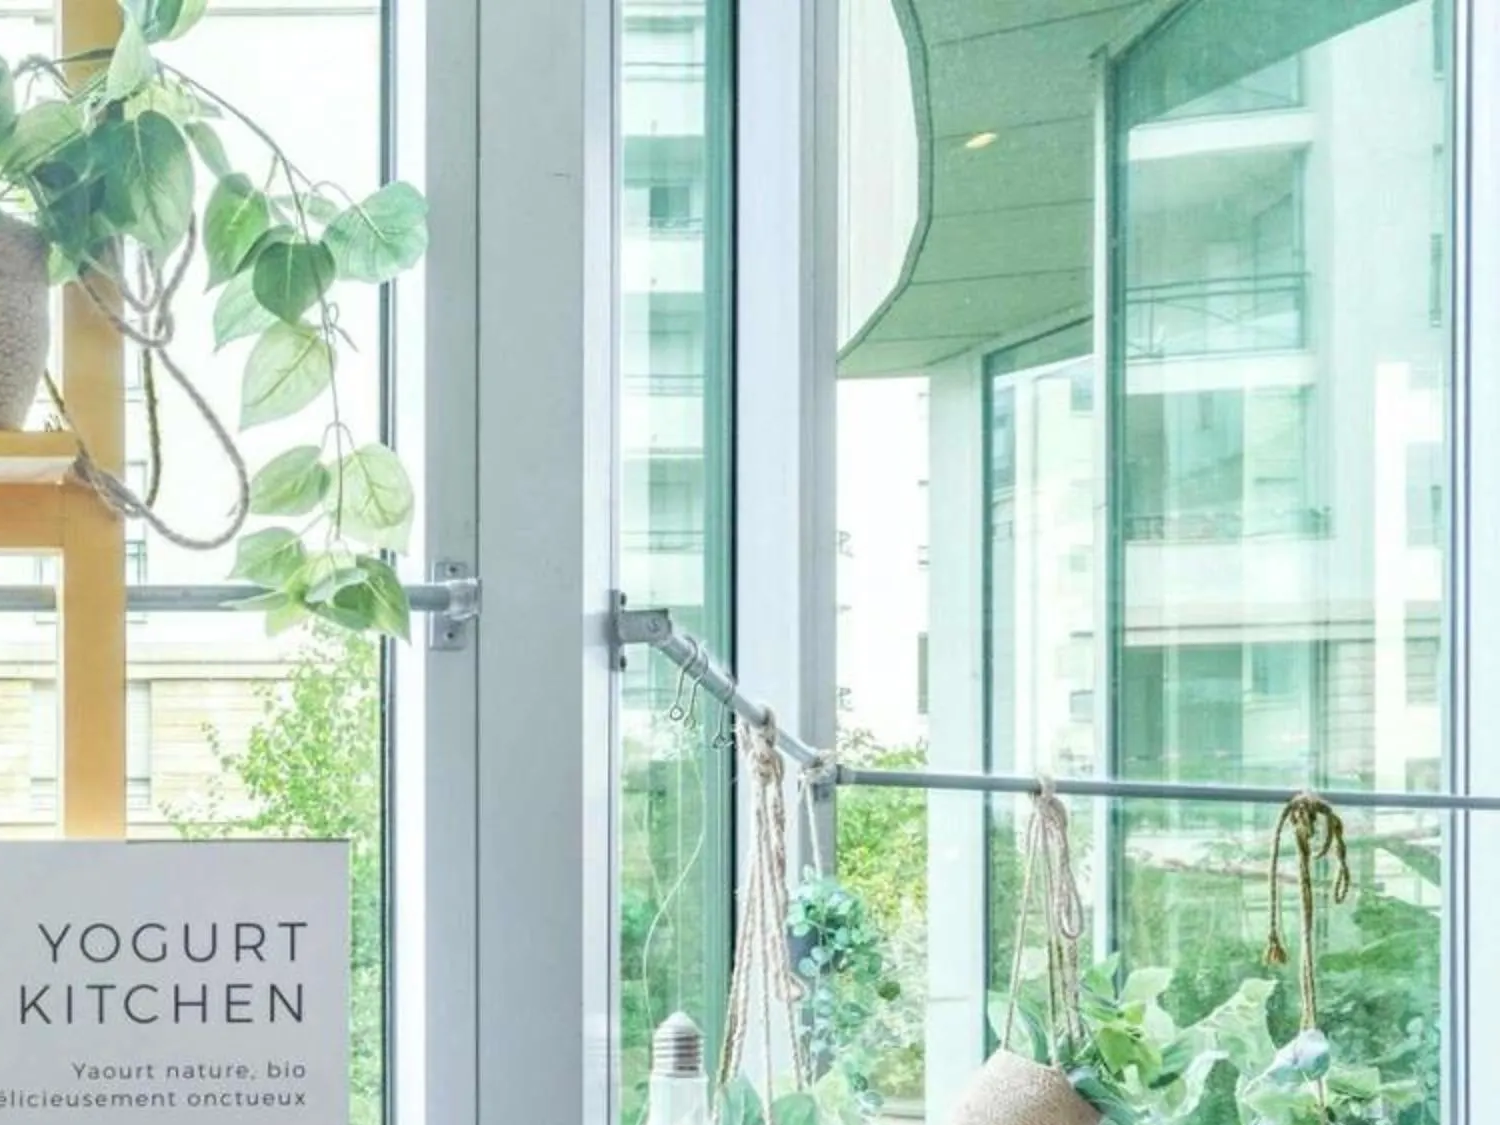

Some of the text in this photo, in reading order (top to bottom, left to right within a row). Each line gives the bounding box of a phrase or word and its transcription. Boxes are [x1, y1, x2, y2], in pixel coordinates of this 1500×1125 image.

[37, 921, 308, 964] YOGURT
[19, 982, 304, 1025] KITCHEN
[72, 1060, 306, 1083] Yaourt nature, bio
[187, 1090, 306, 1108] onctueux
